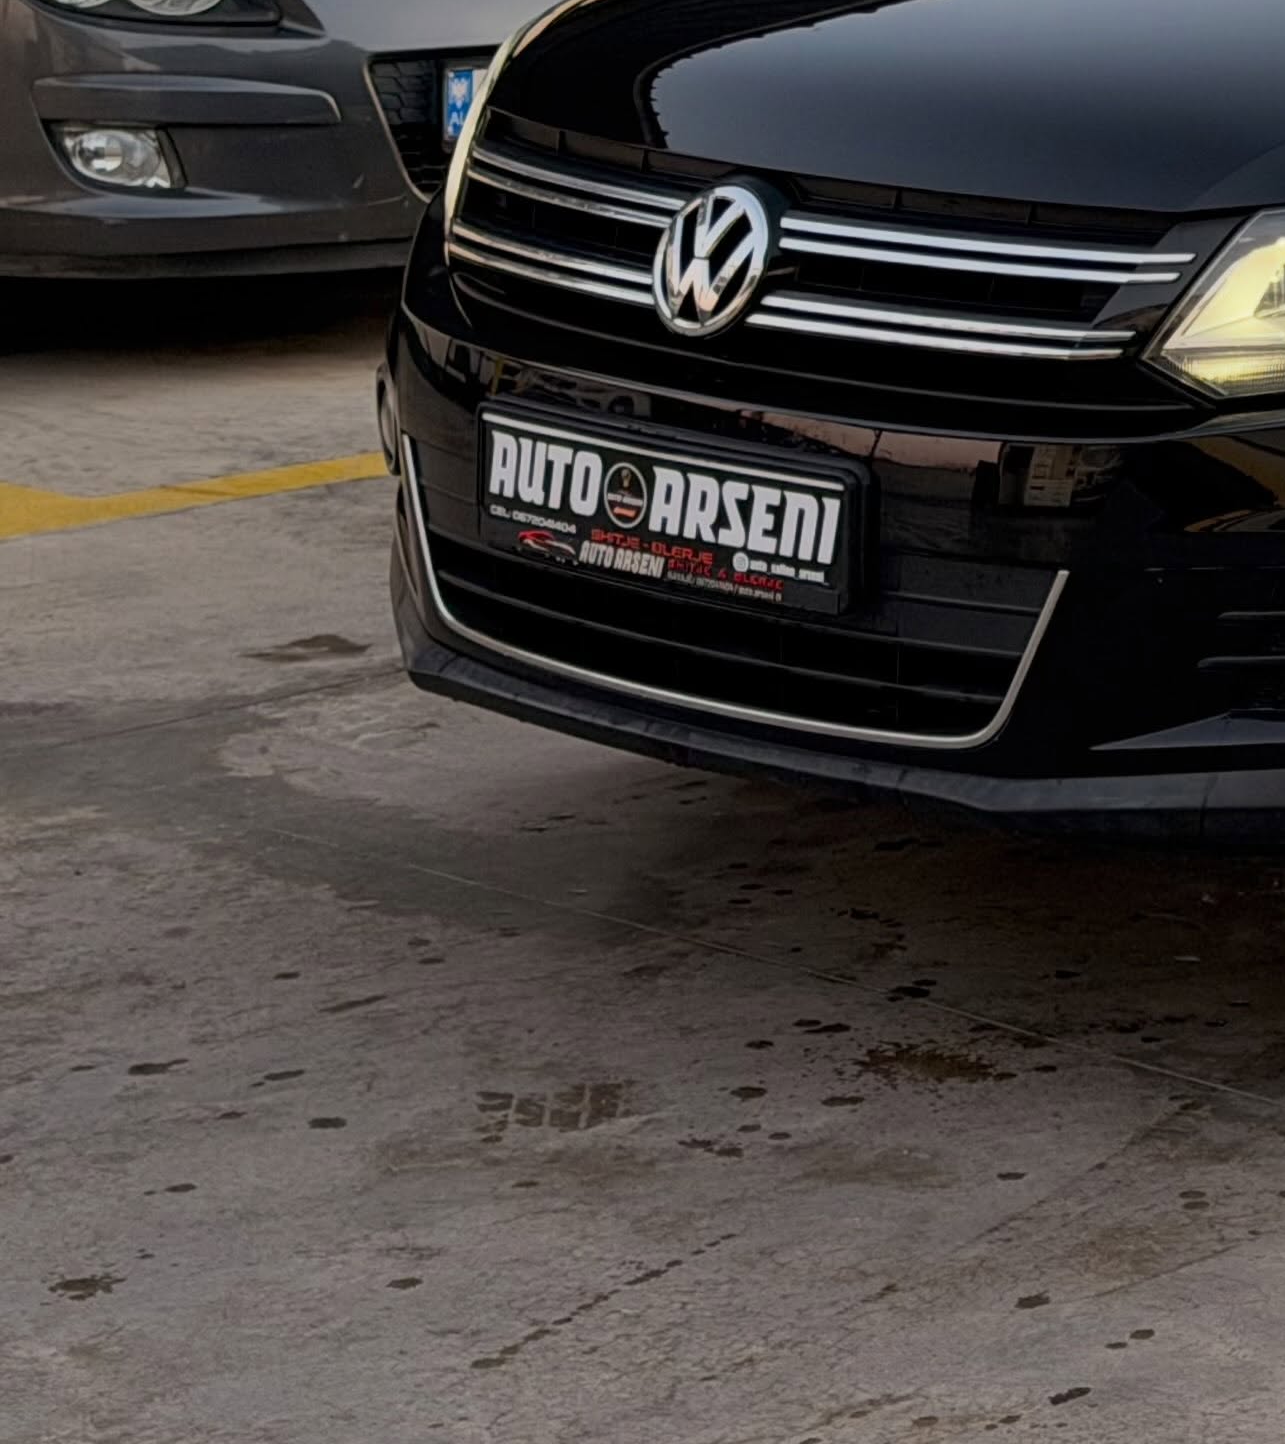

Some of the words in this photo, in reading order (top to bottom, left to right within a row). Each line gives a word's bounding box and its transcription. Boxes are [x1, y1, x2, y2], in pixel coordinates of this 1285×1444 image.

[489, 430, 603, 517] AUTO
[648, 466, 842, 565] ARSENI
[579, 540, 613, 569] AUTO
[613, 547, 666, 578] ARSENI
